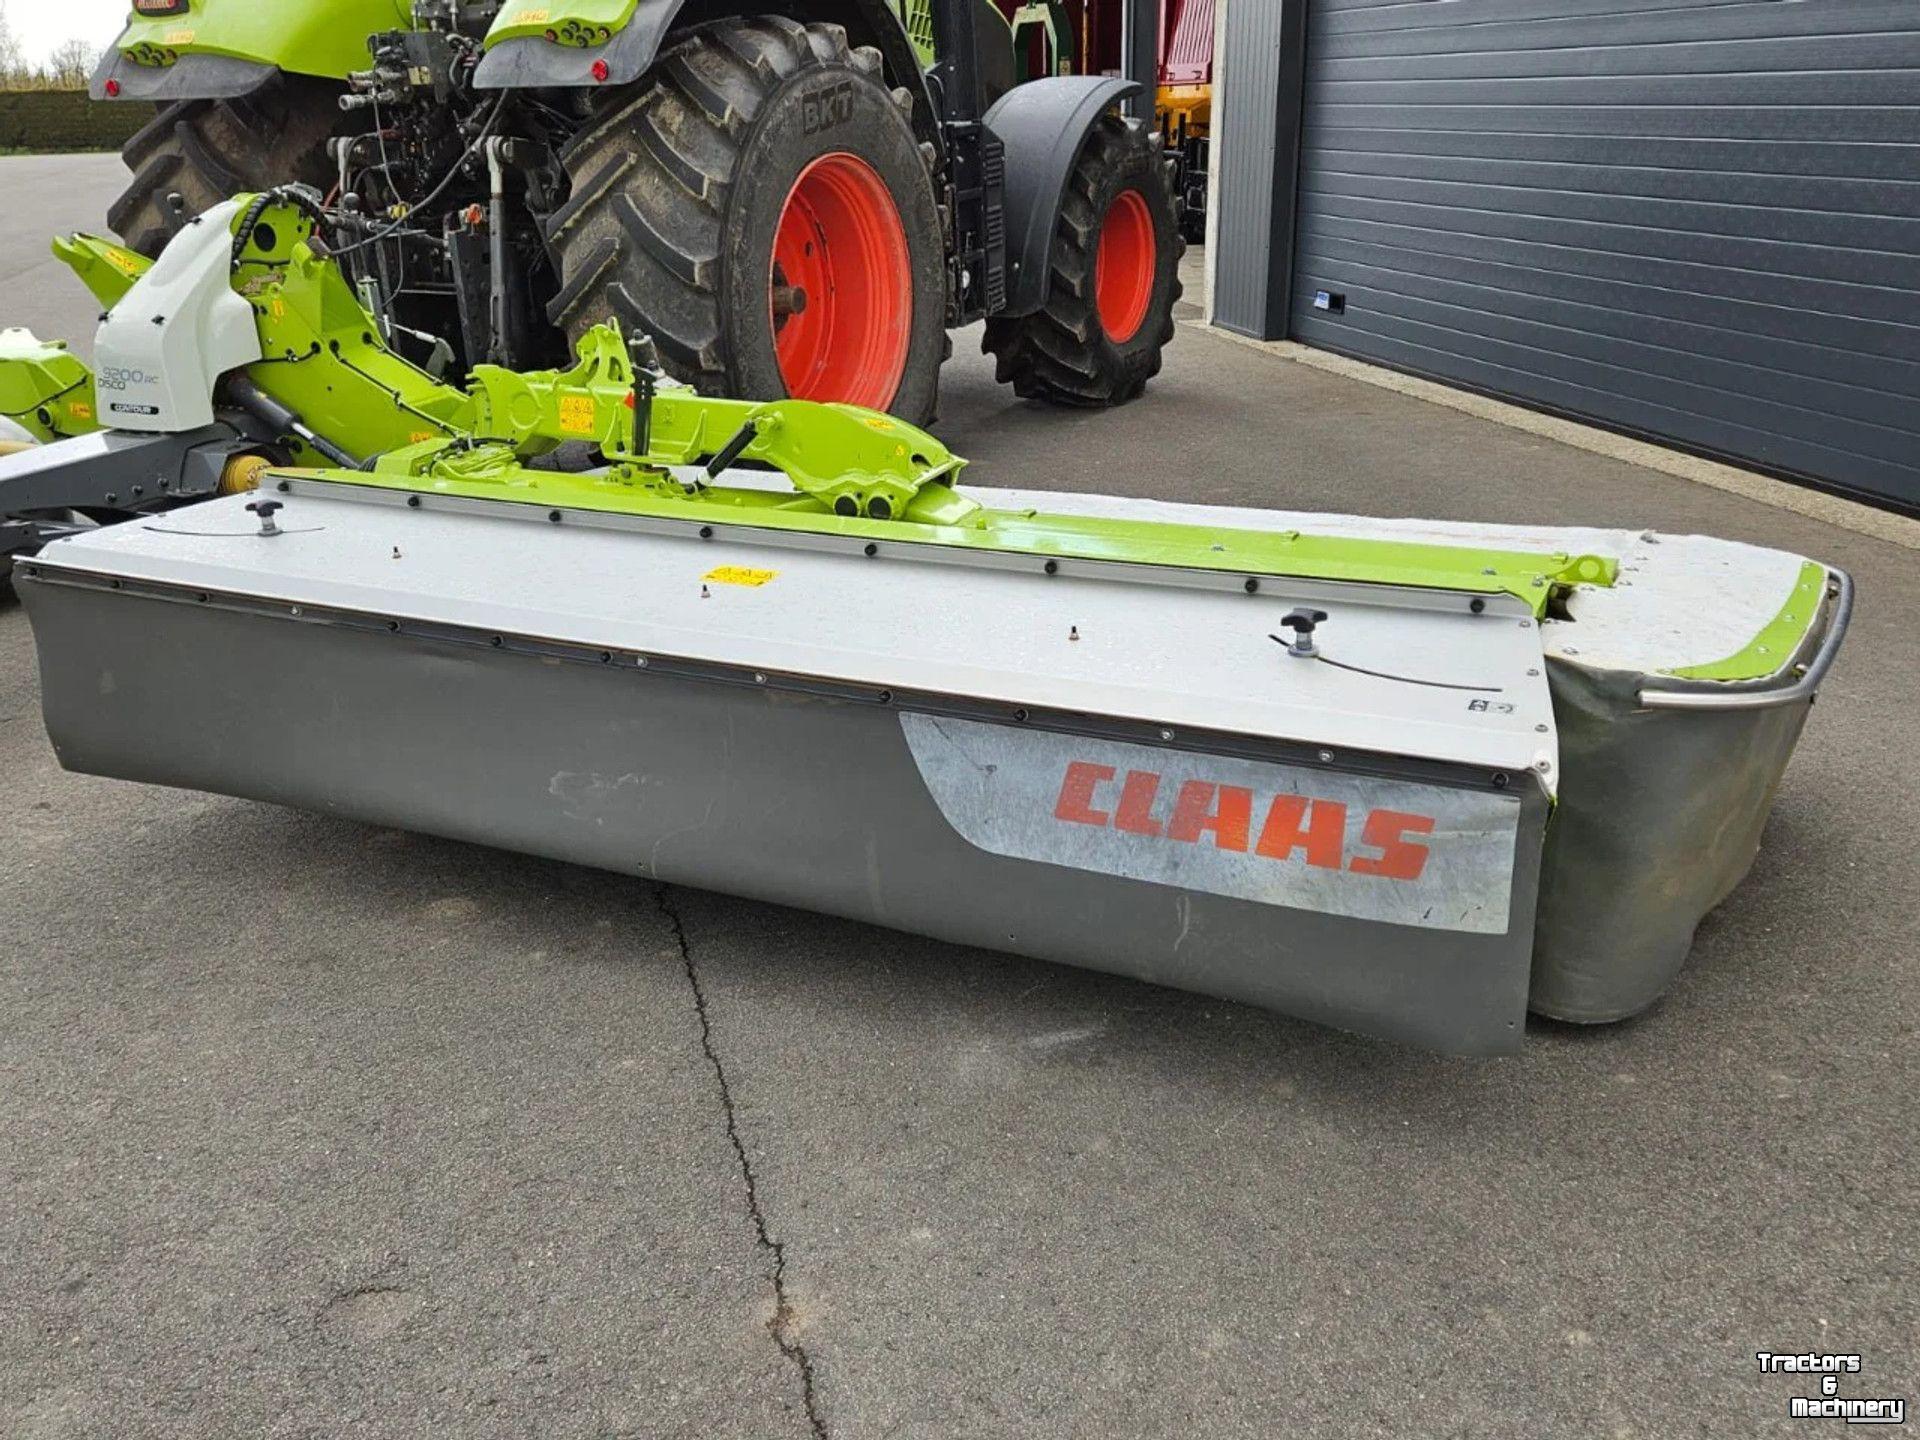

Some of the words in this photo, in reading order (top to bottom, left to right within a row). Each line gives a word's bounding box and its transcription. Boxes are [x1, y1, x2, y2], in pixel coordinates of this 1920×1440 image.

[802, 82, 853, 134] BKT
[102, 366, 143, 383] 9200
[1054, 761, 1435, 880] CLAAS
